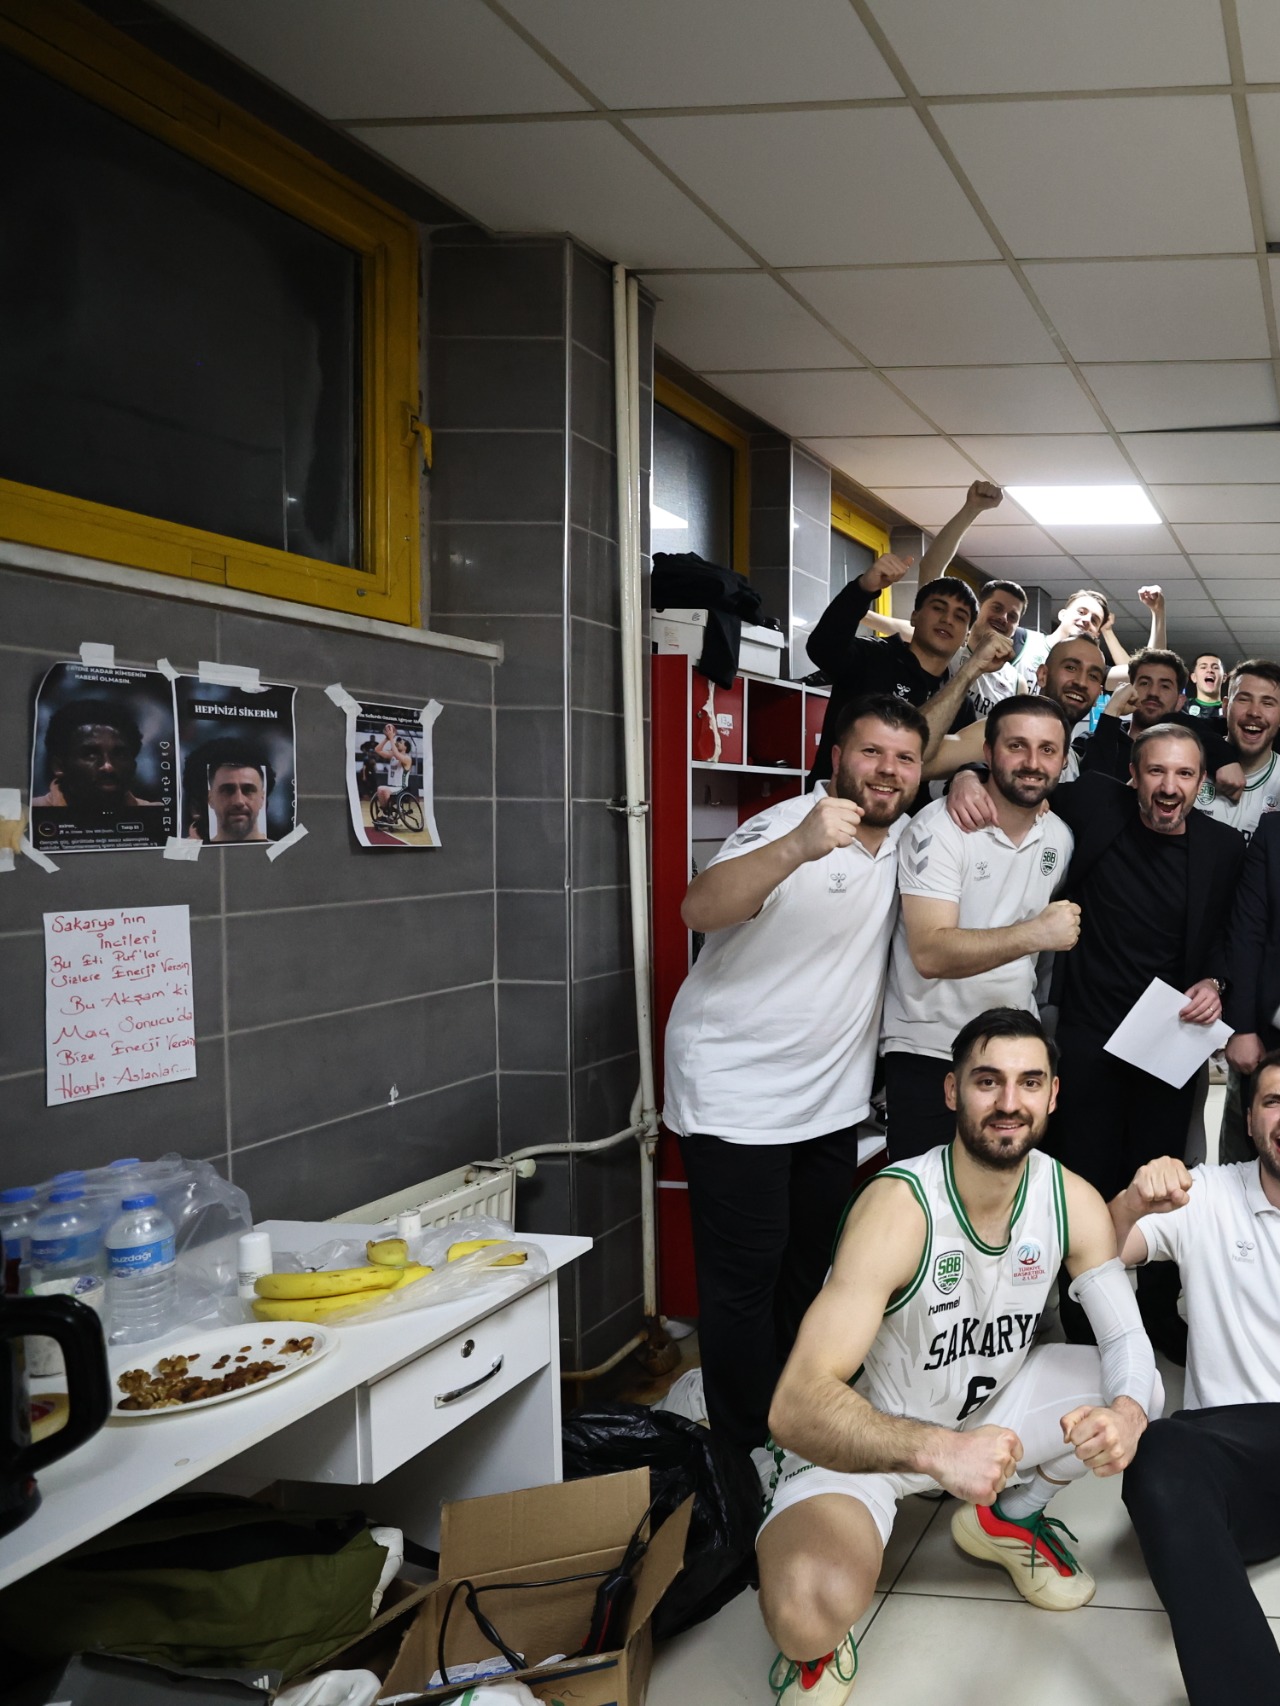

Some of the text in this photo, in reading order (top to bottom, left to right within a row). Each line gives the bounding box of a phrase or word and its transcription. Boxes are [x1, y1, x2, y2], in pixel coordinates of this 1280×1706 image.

[194, 704, 278, 719] HEPİNİZİ SİKERİM
[1042, 851, 1056, 864] SBB
[50, 955, 71, 973] Bu
[60, 995, 95, 1015] Bu
[56, 1049, 95, 1066] Bize
[55, 1071, 105, 1099] Haydi
[938, 1256, 961, 1276] SBB
[928, 1296, 961, 1316] hummel
[957, 1375, 997, 1421] 6
